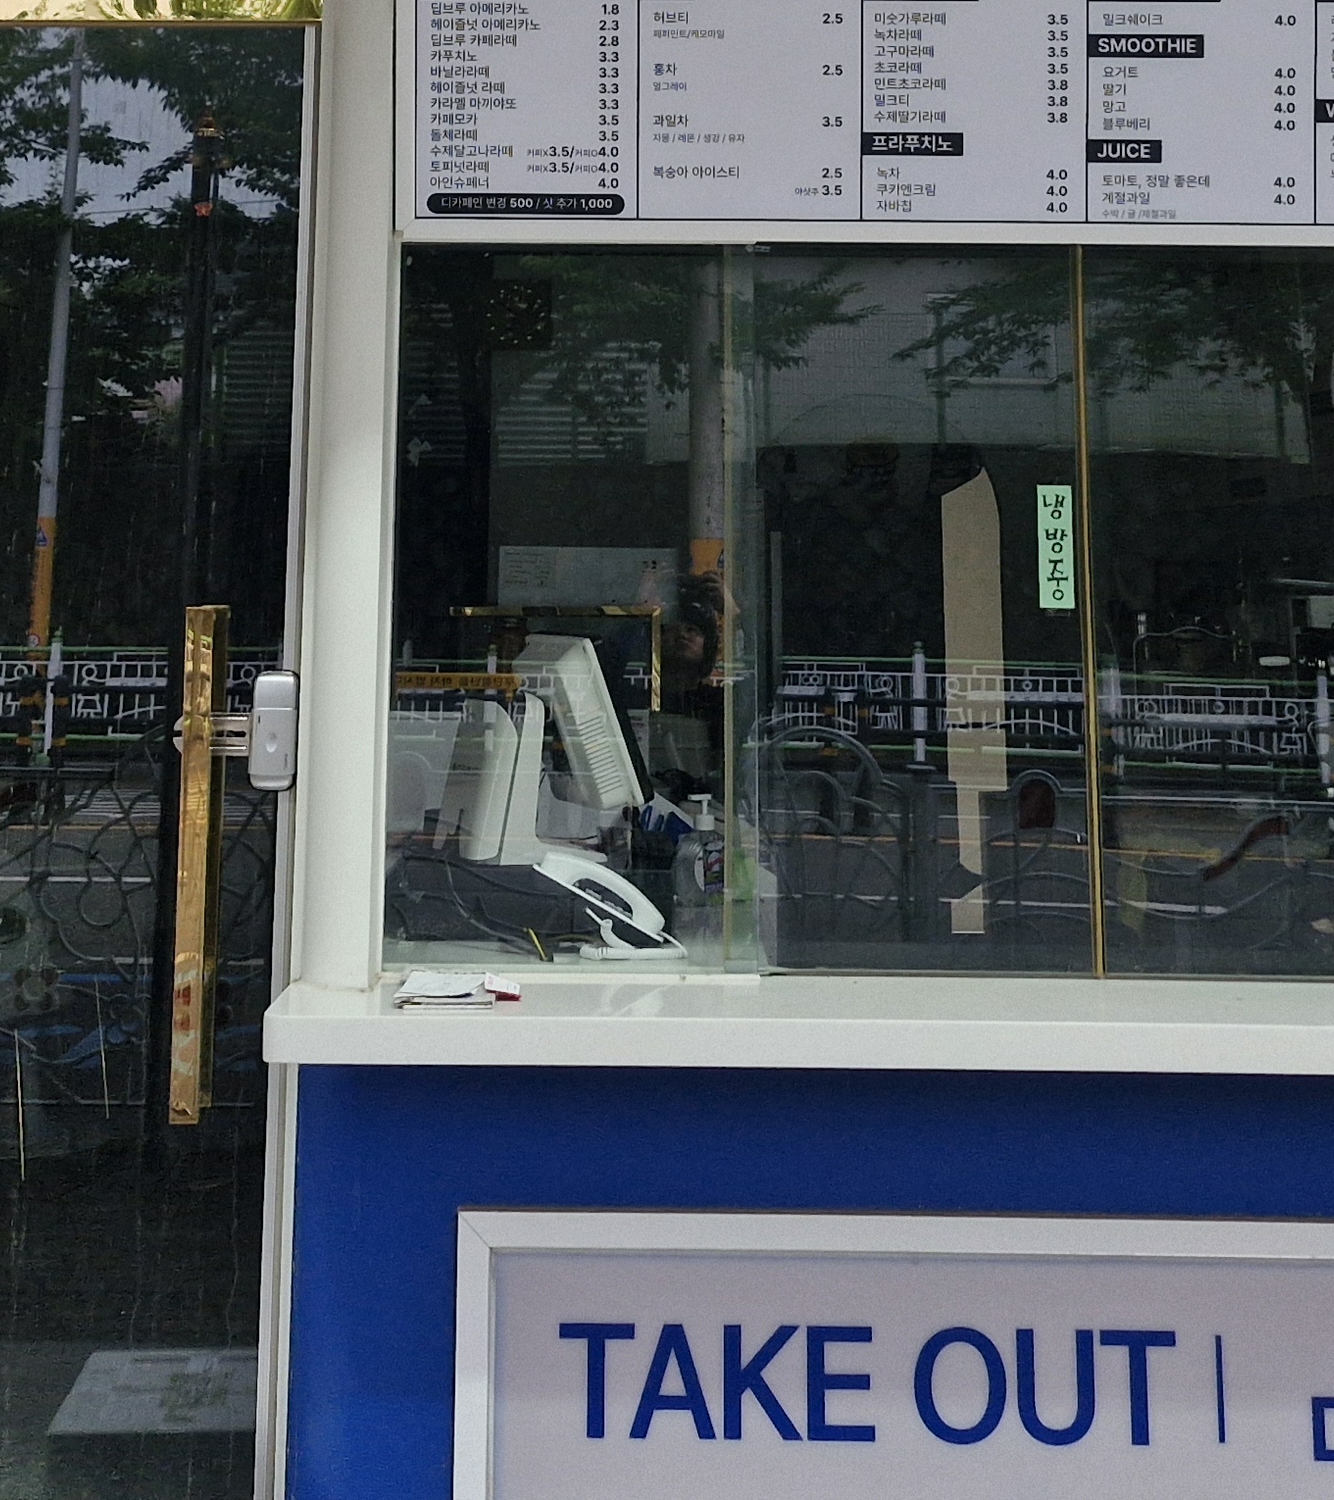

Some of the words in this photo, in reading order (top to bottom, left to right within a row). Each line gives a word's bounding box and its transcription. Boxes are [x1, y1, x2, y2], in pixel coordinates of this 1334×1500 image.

[431, 3, 466, 15] 딥브루
[470, 3, 529, 15] 아메리카노
[602, 4, 619, 14] 1.8
[653, 12, 689, 24] 허브티
[823, 14, 843, 24] 2.5
[875, 13, 946, 25] 미숫가루라떼
[1047, 14, 1068, 25] 3.5
[1275, 15, 1296, 26] 4.0
[482, 19, 541, 31] 아메리카노
[599, 20, 619, 30] 2.3
[431, 34, 466, 46] 딥브루
[470, 34, 517, 46] 카페라떼
[599, 36, 619, 46] 2.8
[875, 29, 921, 41] 녹차라떼
[1047, 31, 1068, 41] 3.5
[1098, 38, 1197, 52] SMOOTHIE
[430, 51, 477, 62] 카푸치노
[599, 52, 619, 62] 3.3
[874, 45, 934, 58] 고구마라떼
[1047, 47, 1068, 57] 3.5
[431, 66, 489, 78] 바닐라라떼
[599, 68, 619, 78] 3.3
[653, 63, 677, 75] 홍차
[823, 65, 843, 75] 2.5
[874, 62, 921, 74] 초코라떼
[1047, 63, 1068, 74] 3.5
[1103, 66, 1138, 78] 요거트
[1275, 68, 1296, 78] 4.0
[482, 82, 505, 94] 라떼
[599, 84, 619, 93] 3.3
[875, 78, 946, 90] 민트초코라떼
[1047, 80, 1068, 90] 3.8
[1103, 83, 1126, 96] 딸기
[1275, 85, 1296, 96] 4.0
[430, 98, 467, 110] 카라멜
[599, 100, 619, 109] 3.3
[875, 94, 909, 106] 밀크티
[1047, 96, 1067, 106] 3.8
[1103, 101, 1126, 113] 망고
[1274, 103, 1295, 113] 4.0
[430, 113, 477, 125] 카페모카
[599, 115, 619, 125] 3.5
[653, 115, 688, 127] 과일차
[822, 116, 842, 126] 3.5
[874, 111, 945, 123] 수제딸기라떼
[1047, 113, 1067, 123] 3.8
[1103, 118, 1150, 130] 블루베리
[1274, 120, 1295, 130] 4.0
[599, 131, 619, 141] 3.5
[872, 136, 953, 152] 프라푸치노
[430, 145, 513, 157] 수제달고나라떼
[1097, 144, 1150, 158] JUICE
[430, 161, 489, 173] 토피넛라떼
[653, 166, 688, 178] 복숭아
[692, 166, 739, 178] 아이스티
[822, 168, 842, 178] 2.5
[877, 167, 900, 179] 녹차
[1046, 169, 1067, 180] 4.0
[430, 177, 489, 189] 아인슈페너
[598, 178, 619, 188] 4.0
[1146, 175, 1169, 188] 정말
[1174, 175, 1210, 188] 좋은데
[1273, 177, 1295, 187] 4.0
[822, 185, 842, 195] 3.5
[1046, 186, 1067, 196] 4.0
[441, 197, 483, 208] 디카페인
[510, 199, 532, 208] 500
[556, 198, 577, 209] 추가
[580, 199, 613, 210] 1,000
[1102, 192, 1150, 204] 계절과일
[1273, 194, 1295, 205] 4.0
[877, 200, 912, 212] 자바칩
[1046, 202, 1067, 213] 4.0
[1043, 494, 1068, 600] 냉방중
[559, 1322, 874, 1444] TAKE
[914, 1327, 1177, 1448] OUT
